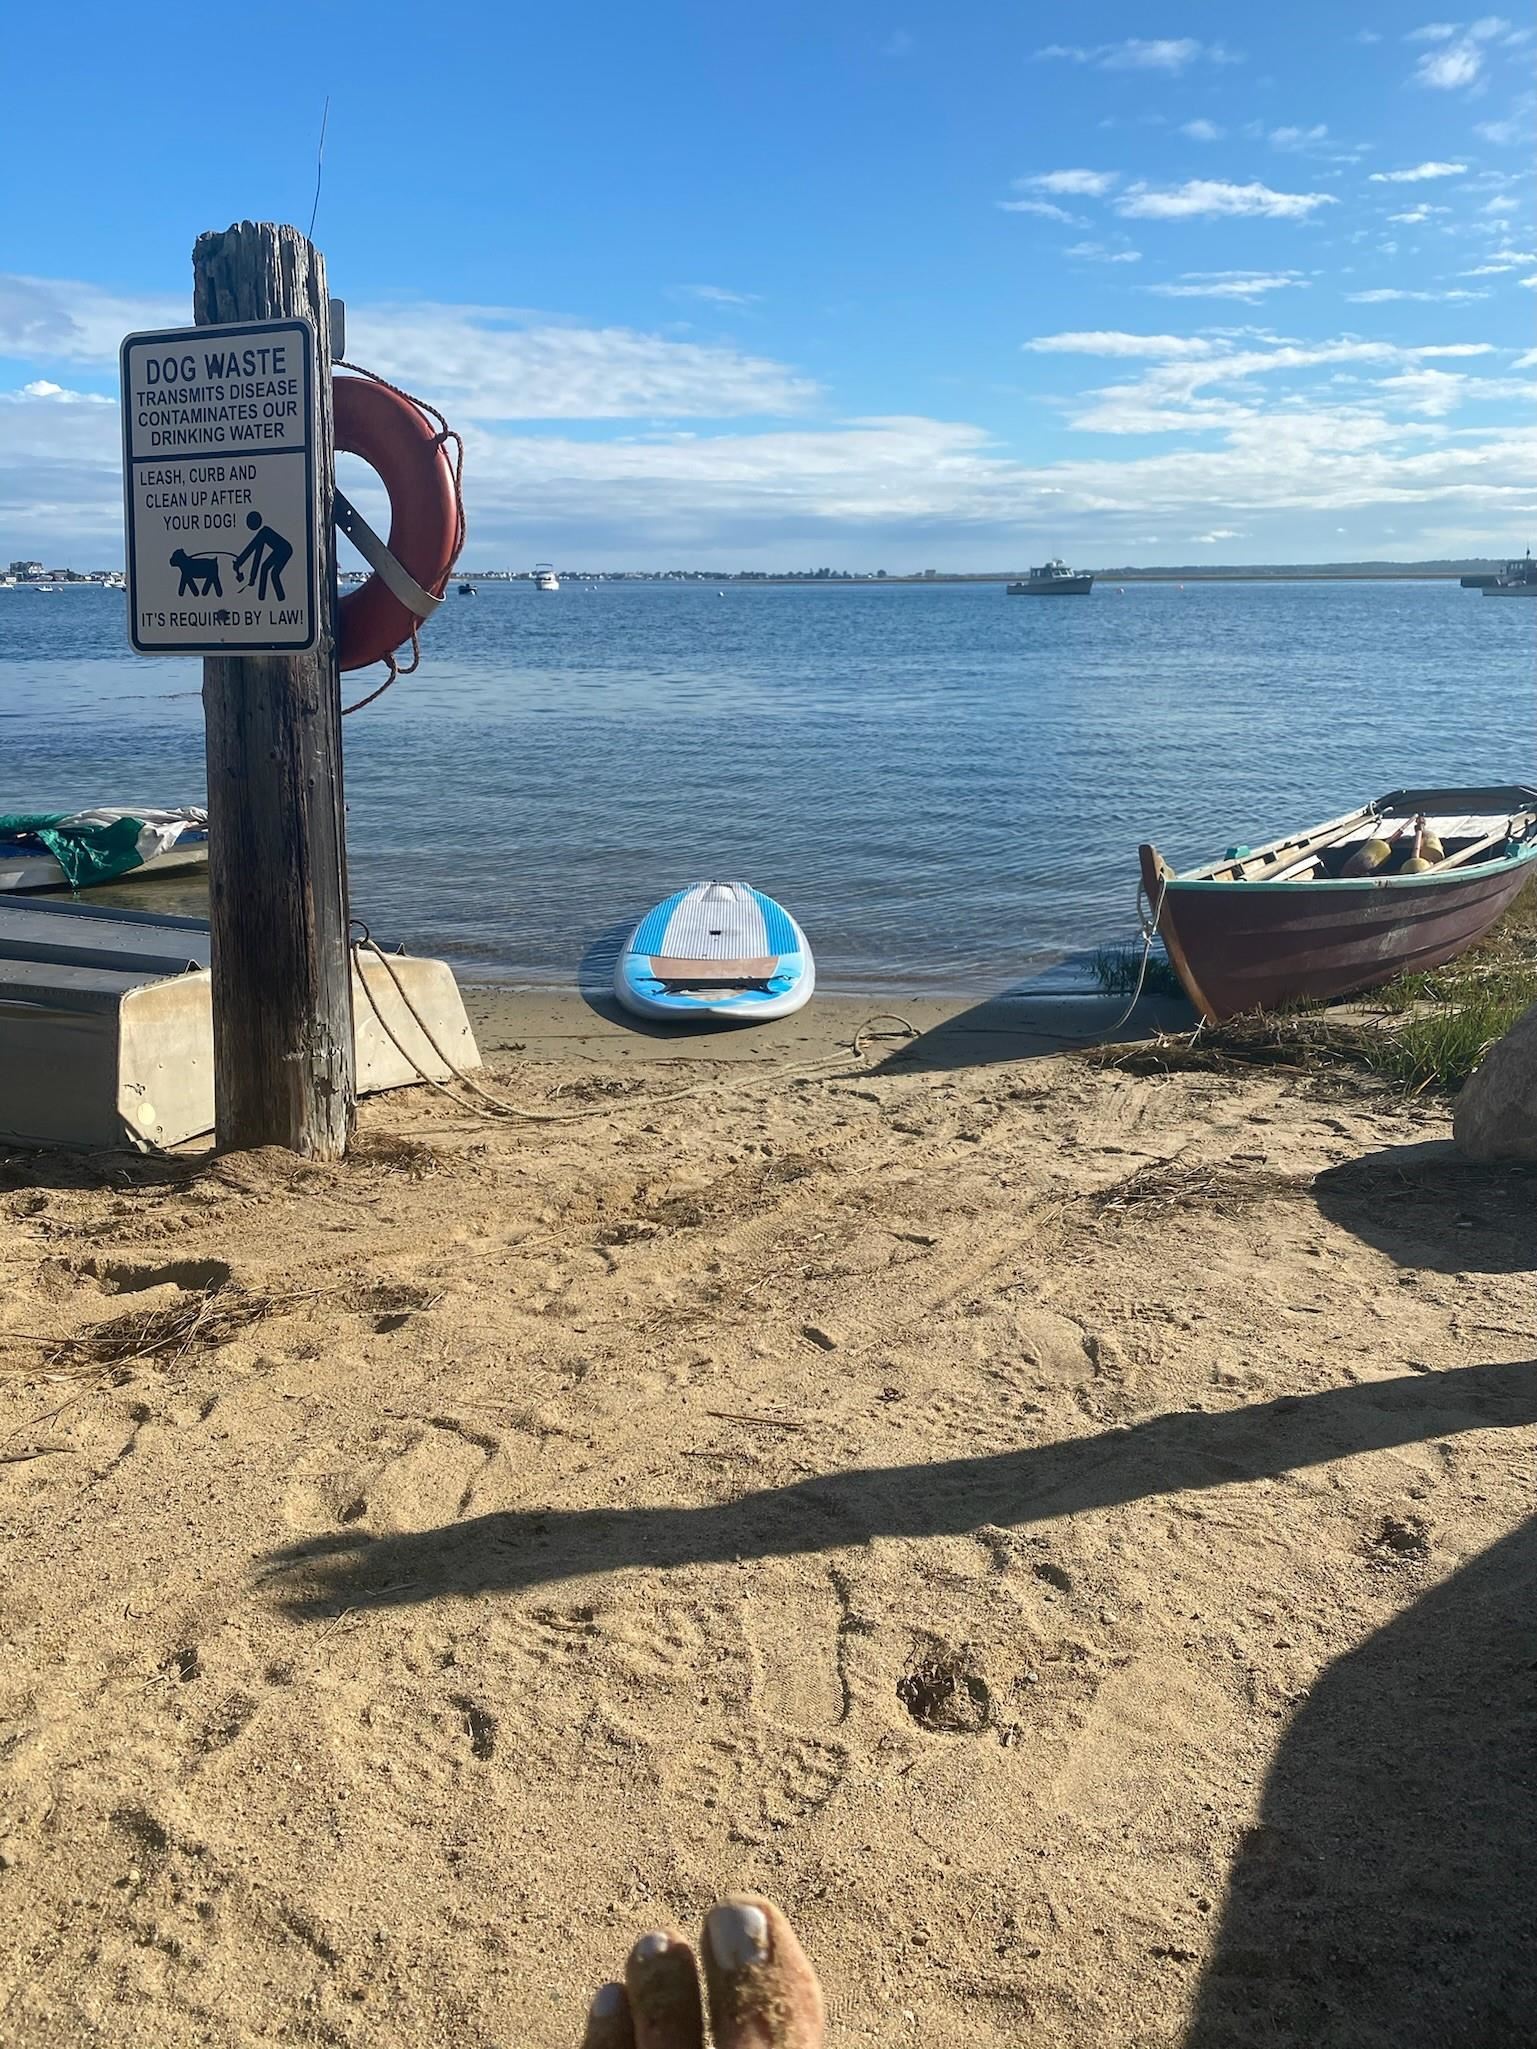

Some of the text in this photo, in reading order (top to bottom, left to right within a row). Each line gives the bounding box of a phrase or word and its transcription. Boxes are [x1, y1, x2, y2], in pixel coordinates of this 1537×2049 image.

[146, 347, 286, 385] DOG WASTE
[137, 379, 298, 407] TRANSMITS DISEASE
[138, 401, 297, 427] CONTAMINATES OUR
[151, 422, 285, 446] DRINKING WATER
[140, 465, 257, 486] LEASH, CURB AND
[146, 489, 252, 508] CLEAN UP AFTER
[163, 513, 236, 531] YOUR DOG!
[142, 609, 304, 627] IT'S REQUIRED BY LAW!
